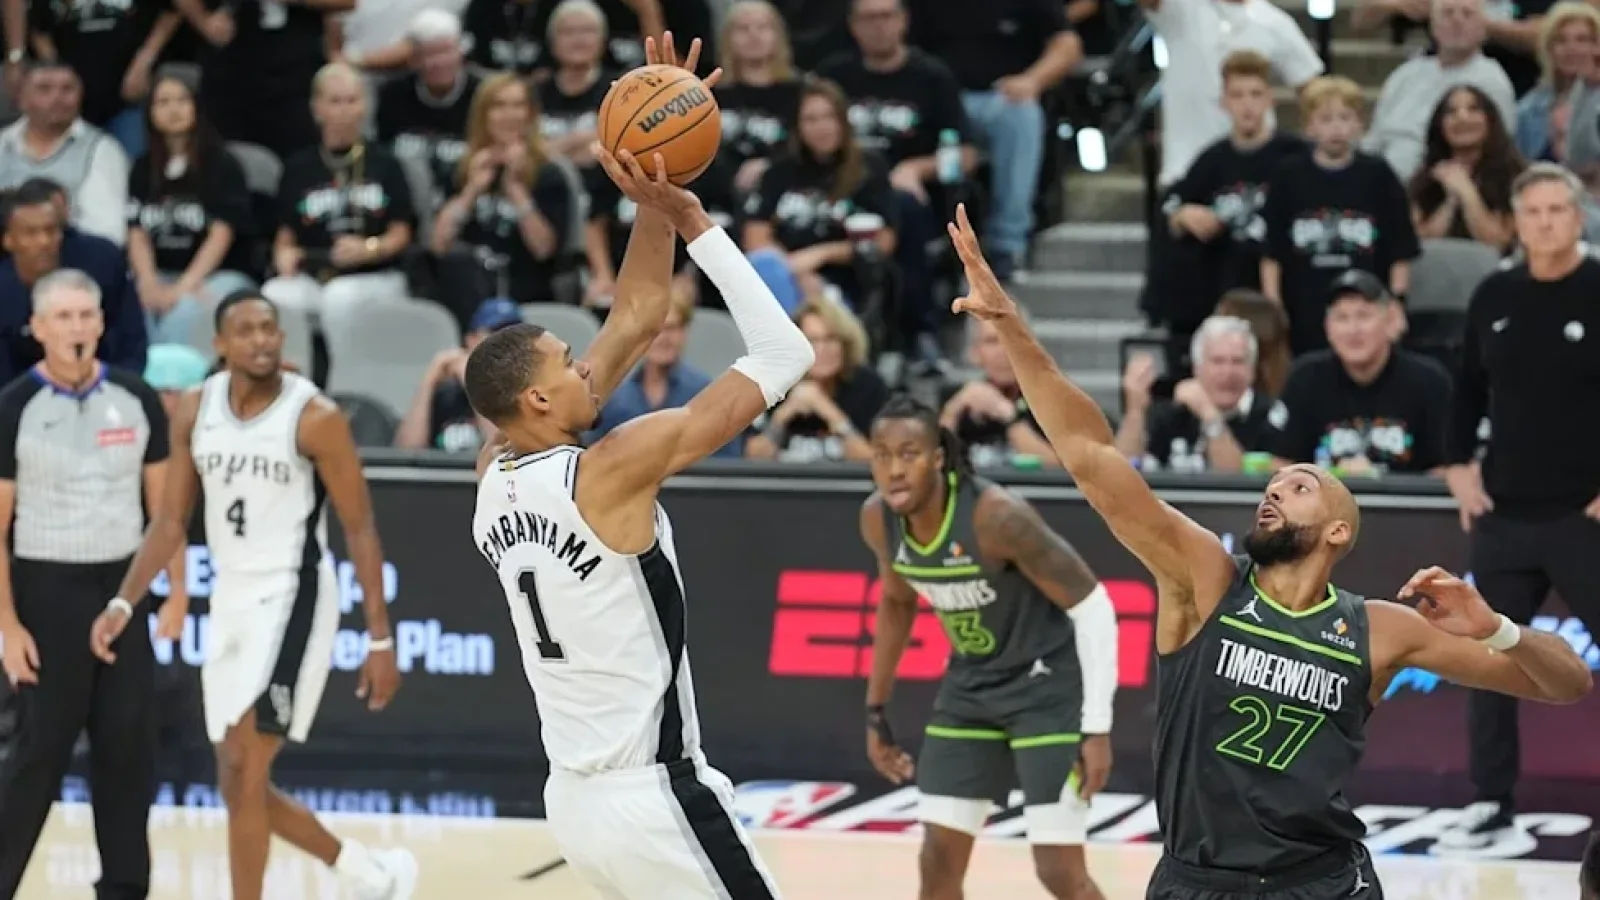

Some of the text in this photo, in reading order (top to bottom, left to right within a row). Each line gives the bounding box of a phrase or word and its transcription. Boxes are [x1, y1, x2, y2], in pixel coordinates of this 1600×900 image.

[637, 86, 709, 133] Wilson
[226, 497, 246, 538] 4
[481, 510, 603, 582] EMBANYAMA
[515, 566, 569, 663] 1
[1320, 630, 1357, 650] sezzle
[396, 619, 495, 676] Plan
[1215, 638, 1349, 712] TIMBERWOLVES
[1215, 695, 1327, 771] 27
